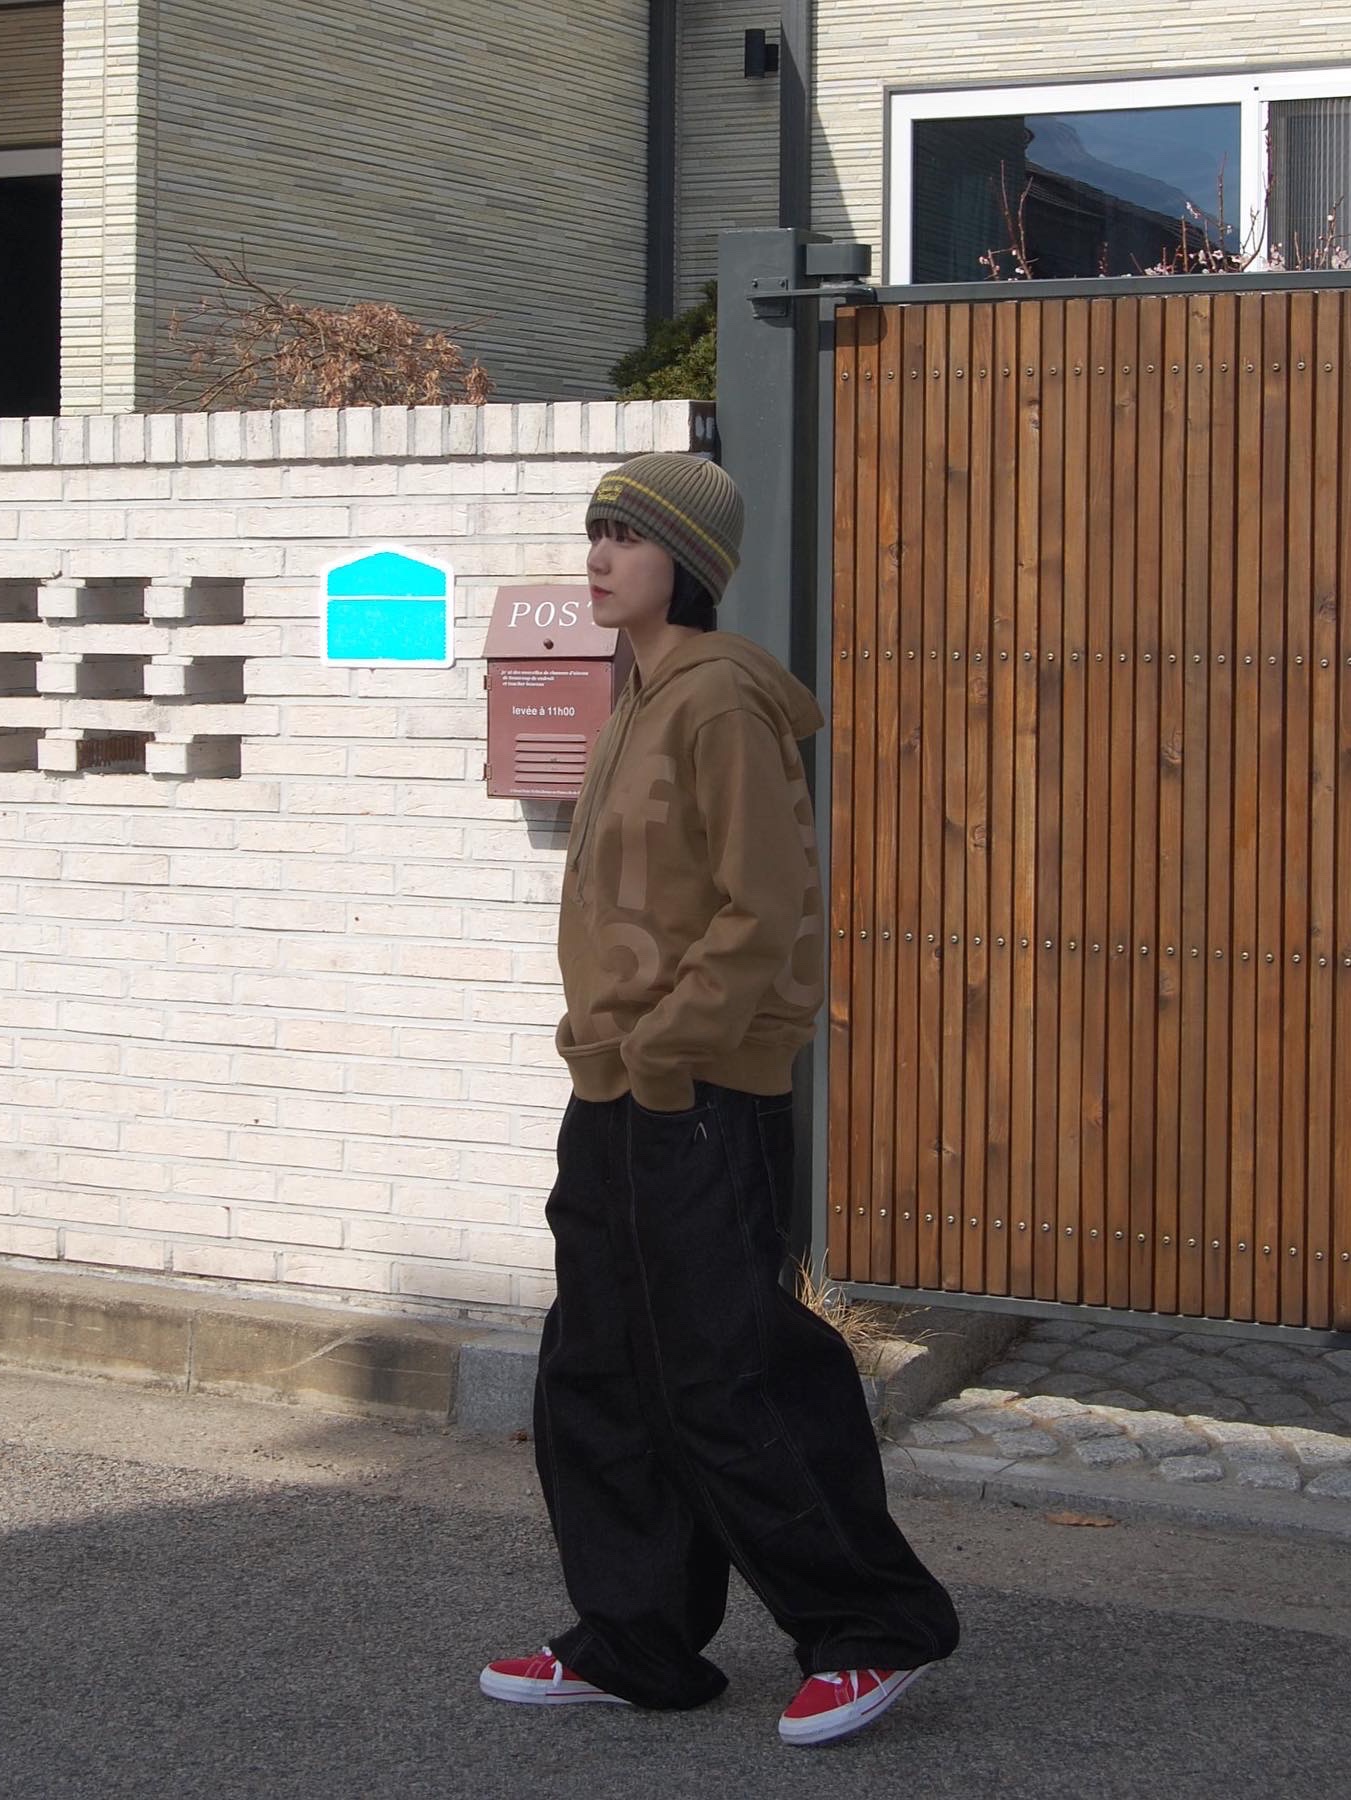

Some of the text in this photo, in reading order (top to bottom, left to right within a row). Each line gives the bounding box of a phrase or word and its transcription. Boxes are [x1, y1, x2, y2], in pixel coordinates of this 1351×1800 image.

[507, 601, 595, 628] POS
[512, 705, 538, 716] levée
[547, 706, 576, 717] 11h00
